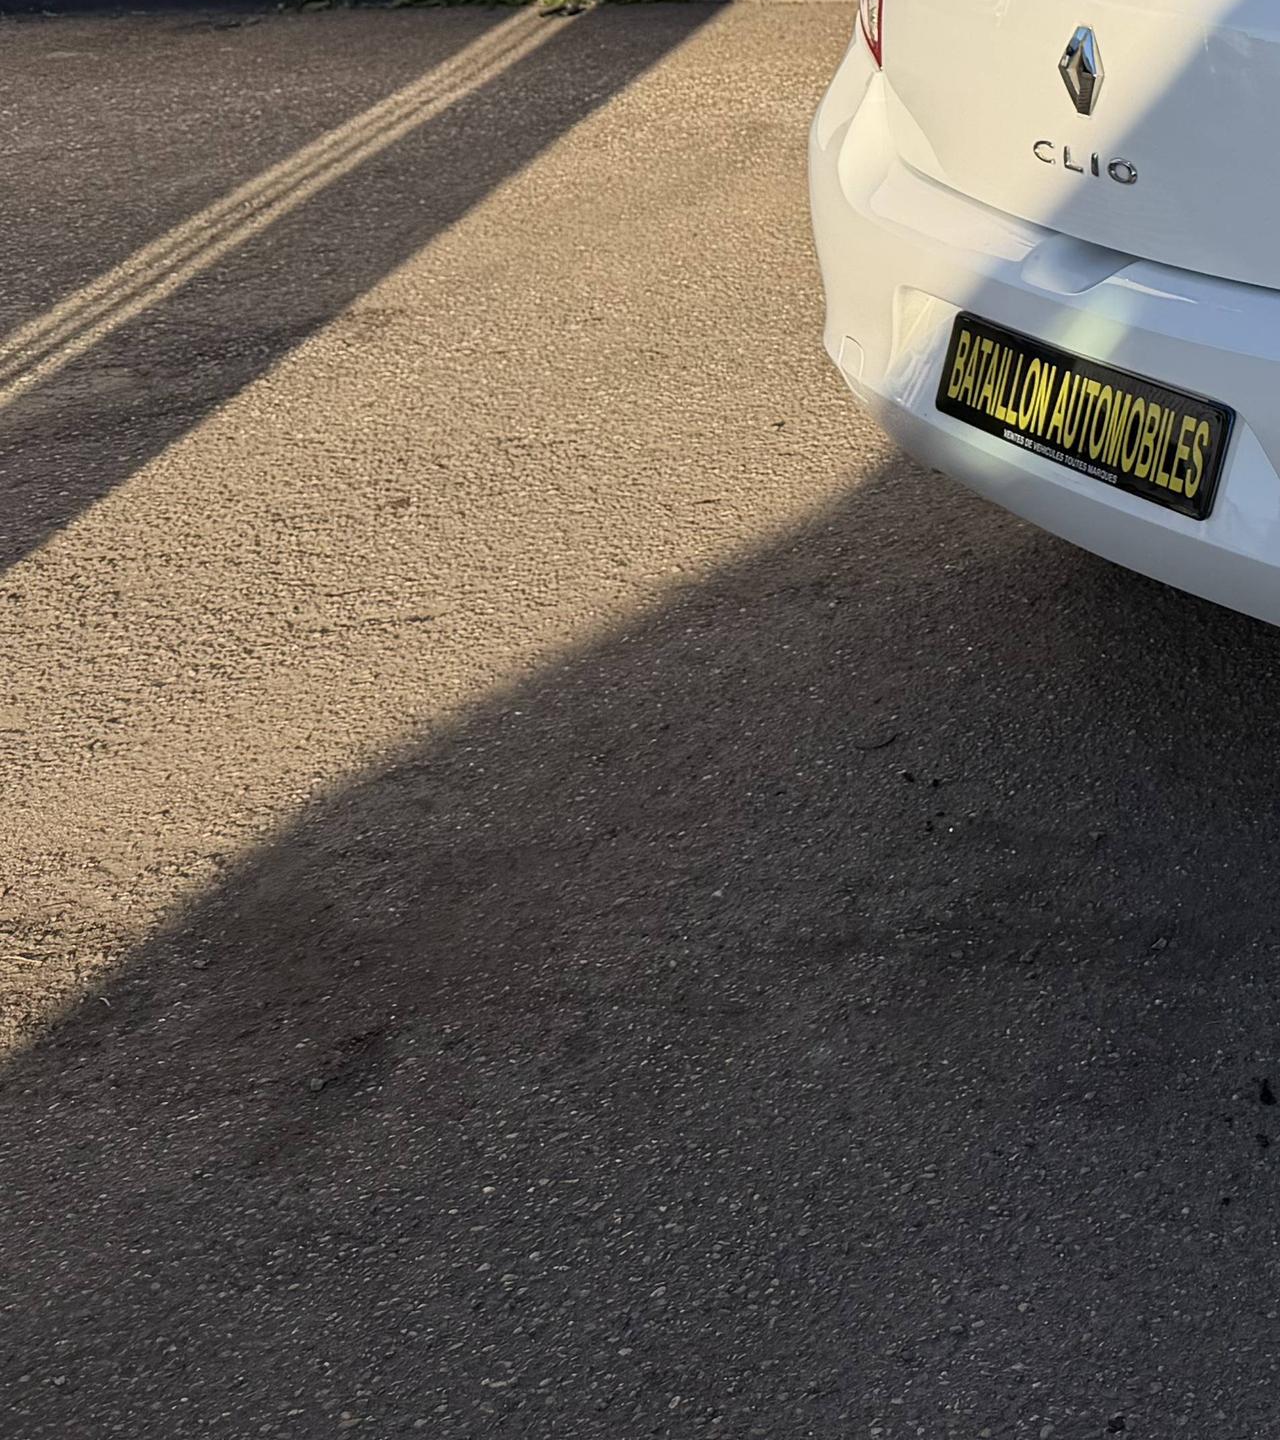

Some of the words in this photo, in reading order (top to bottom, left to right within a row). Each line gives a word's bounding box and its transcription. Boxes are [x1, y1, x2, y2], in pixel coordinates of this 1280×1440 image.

[1033, 140, 1138, 185] CLIO
[947, 329, 1057, 437] BATAILLON
[1046, 370, 1210, 499] AUTOMOBILES
[1003, 428, 1025, 446] VENTES
[1024, 438, 1034, 449] DE
[1065, 454, 1088, 472] TOUTES
[1087, 464, 1119, 484] MARQUES
